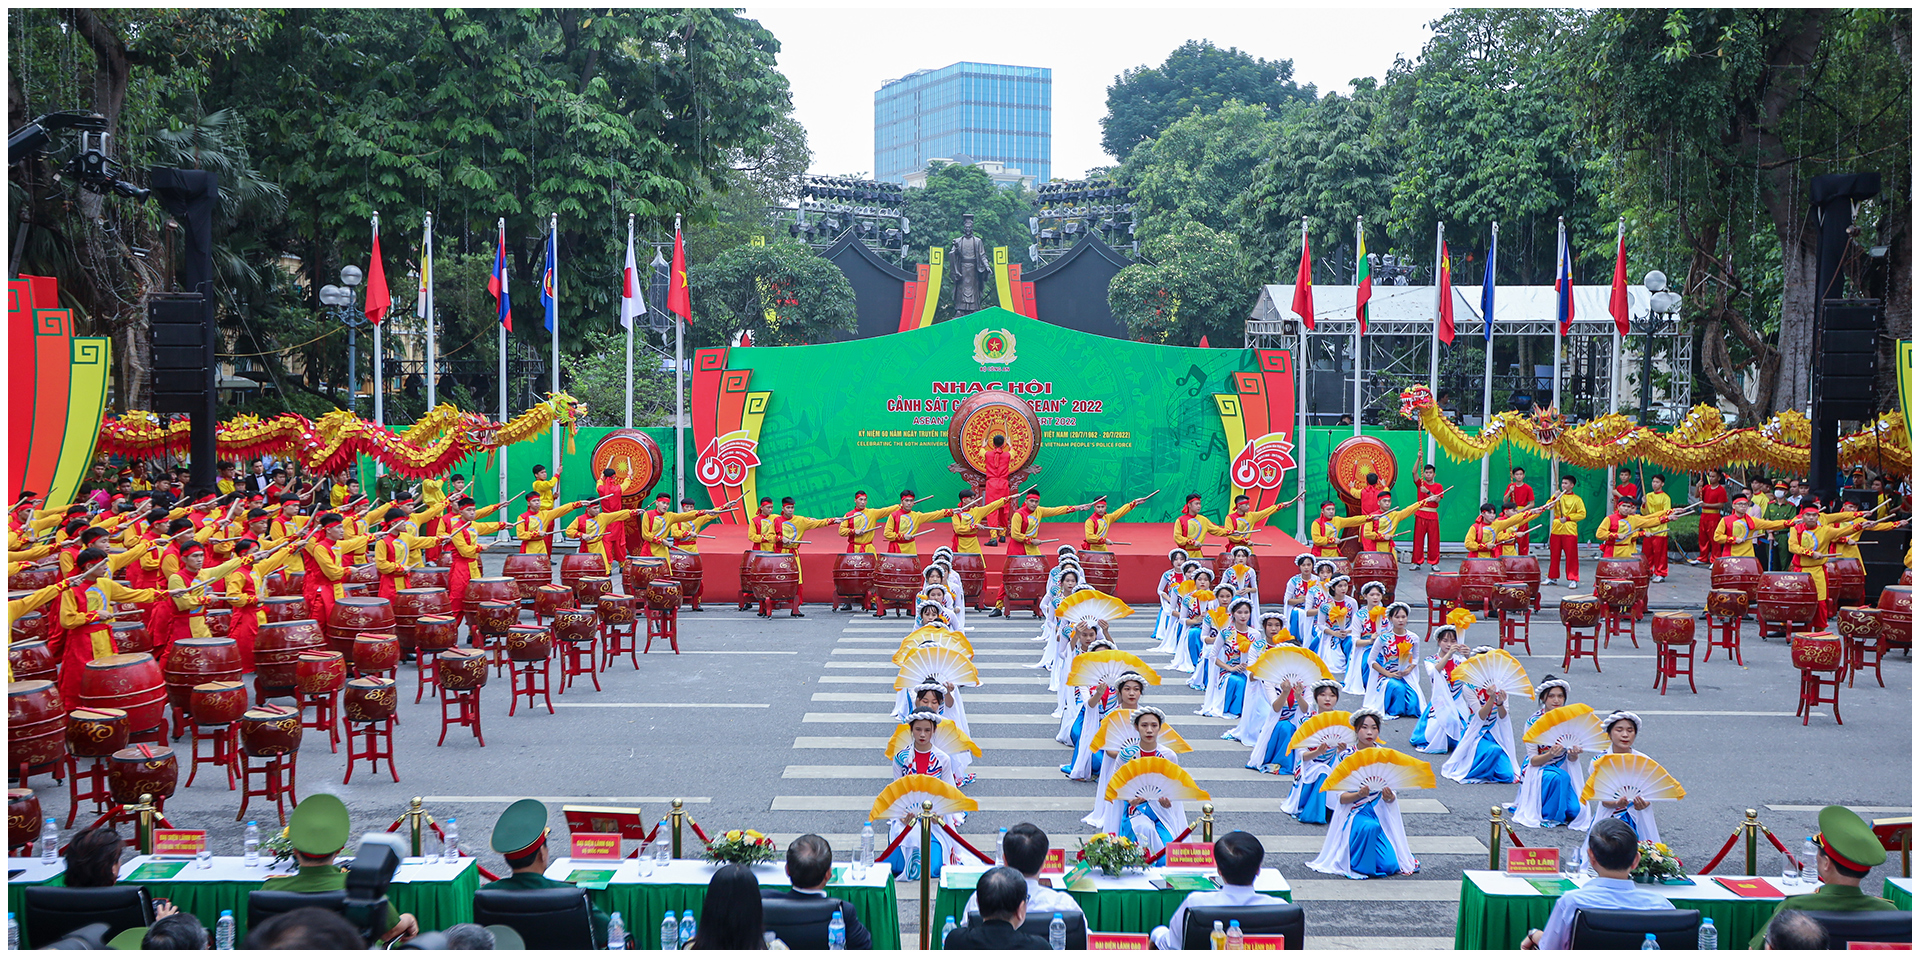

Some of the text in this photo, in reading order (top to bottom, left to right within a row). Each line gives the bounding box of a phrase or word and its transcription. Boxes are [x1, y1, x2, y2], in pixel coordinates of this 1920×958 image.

[1008, 379, 1052, 396] HỘI
[887, 395, 922, 412] CẢNH
[925, 396, 948, 412] SÁT
[1071, 400, 1103, 412] 2022
[1054, 417, 1077, 425] 2022
[866, 429, 880, 438] NIỆM
[1044, 430, 1055, 439] VIỆT
[1538, 858, 1555, 866] LÂM
